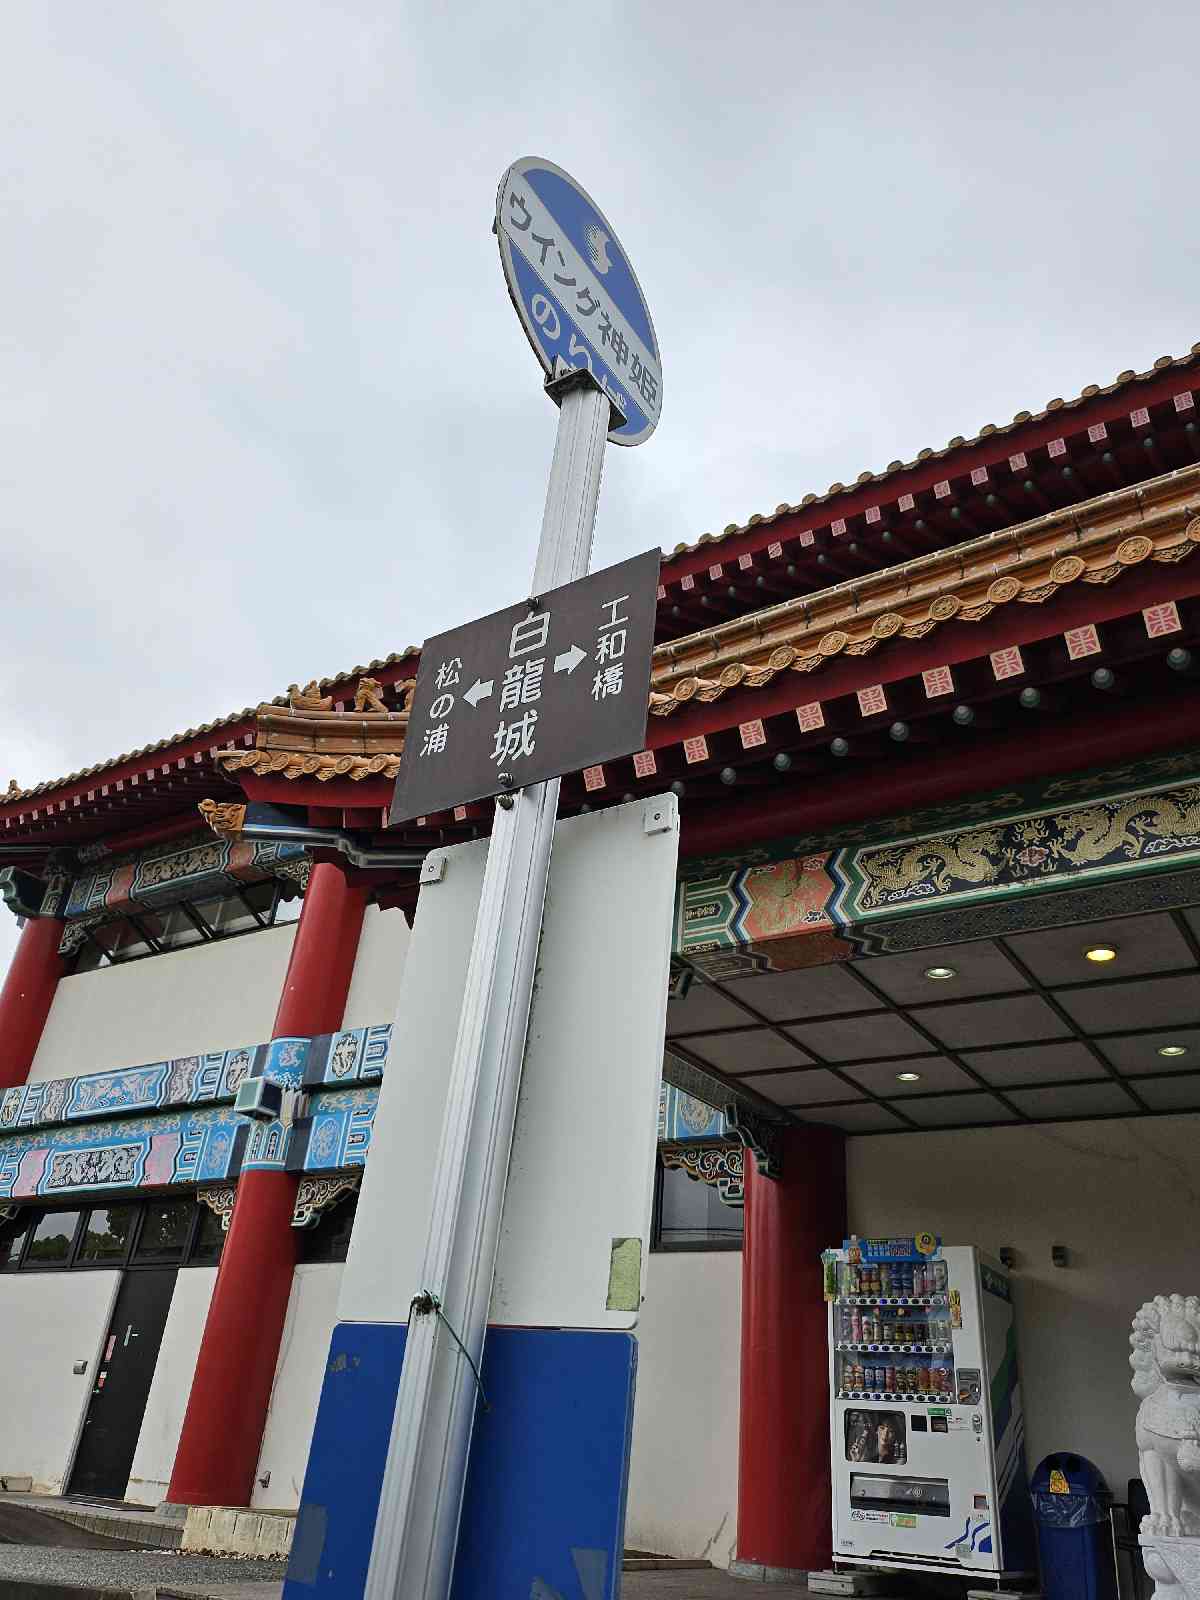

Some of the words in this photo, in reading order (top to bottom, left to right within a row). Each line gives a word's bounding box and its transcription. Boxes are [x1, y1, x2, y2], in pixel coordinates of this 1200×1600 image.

[510, 191, 657, 411] ウイング神姫
[420, 658, 462, 757] 松の浦
[490, 611, 550, 766] 白龍城
[591, 595, 629, 701] 工和橋
